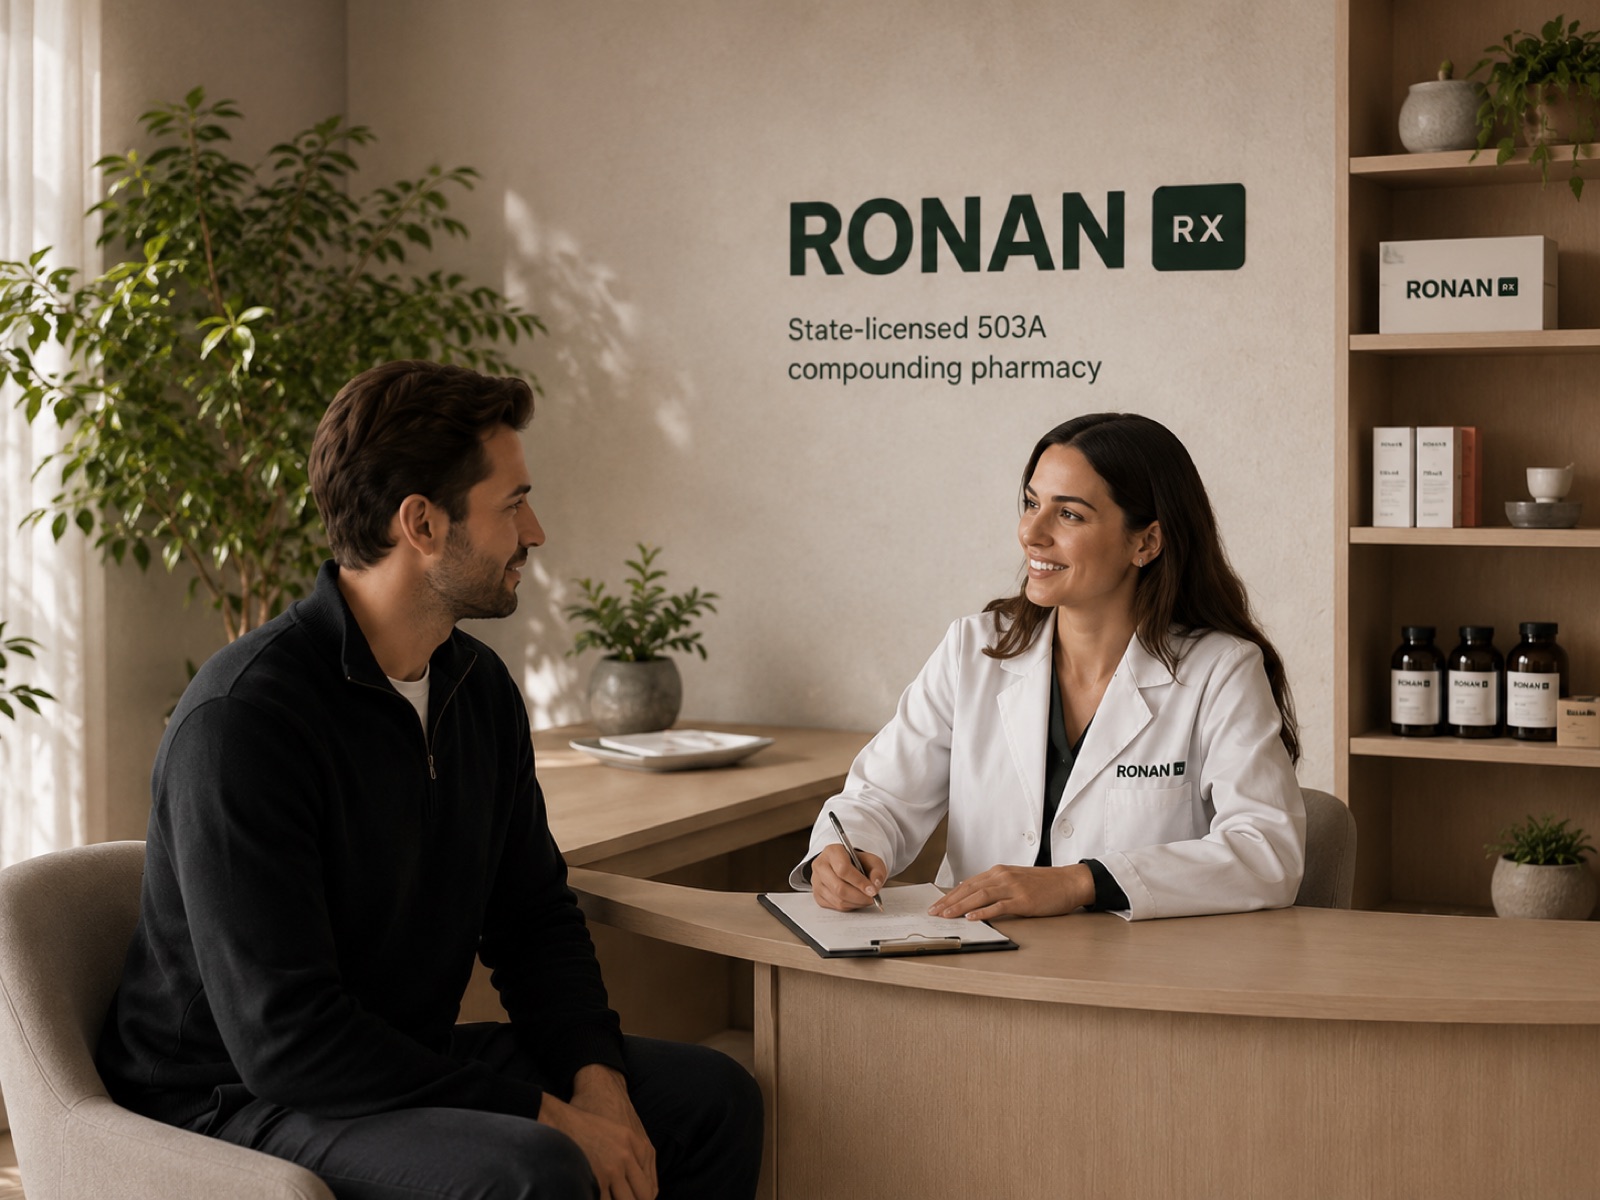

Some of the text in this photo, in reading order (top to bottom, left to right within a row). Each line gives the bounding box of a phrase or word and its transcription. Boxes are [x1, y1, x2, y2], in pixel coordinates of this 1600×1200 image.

[790, 190, 1224, 276] RONAN RX
[1406, 278, 1492, 299] RONAN
[788, 314, 1047, 342] State-licensed 503A
[788, 354, 1102, 385] compounding pharmacy
[1116, 763, 1170, 777] RONAN
